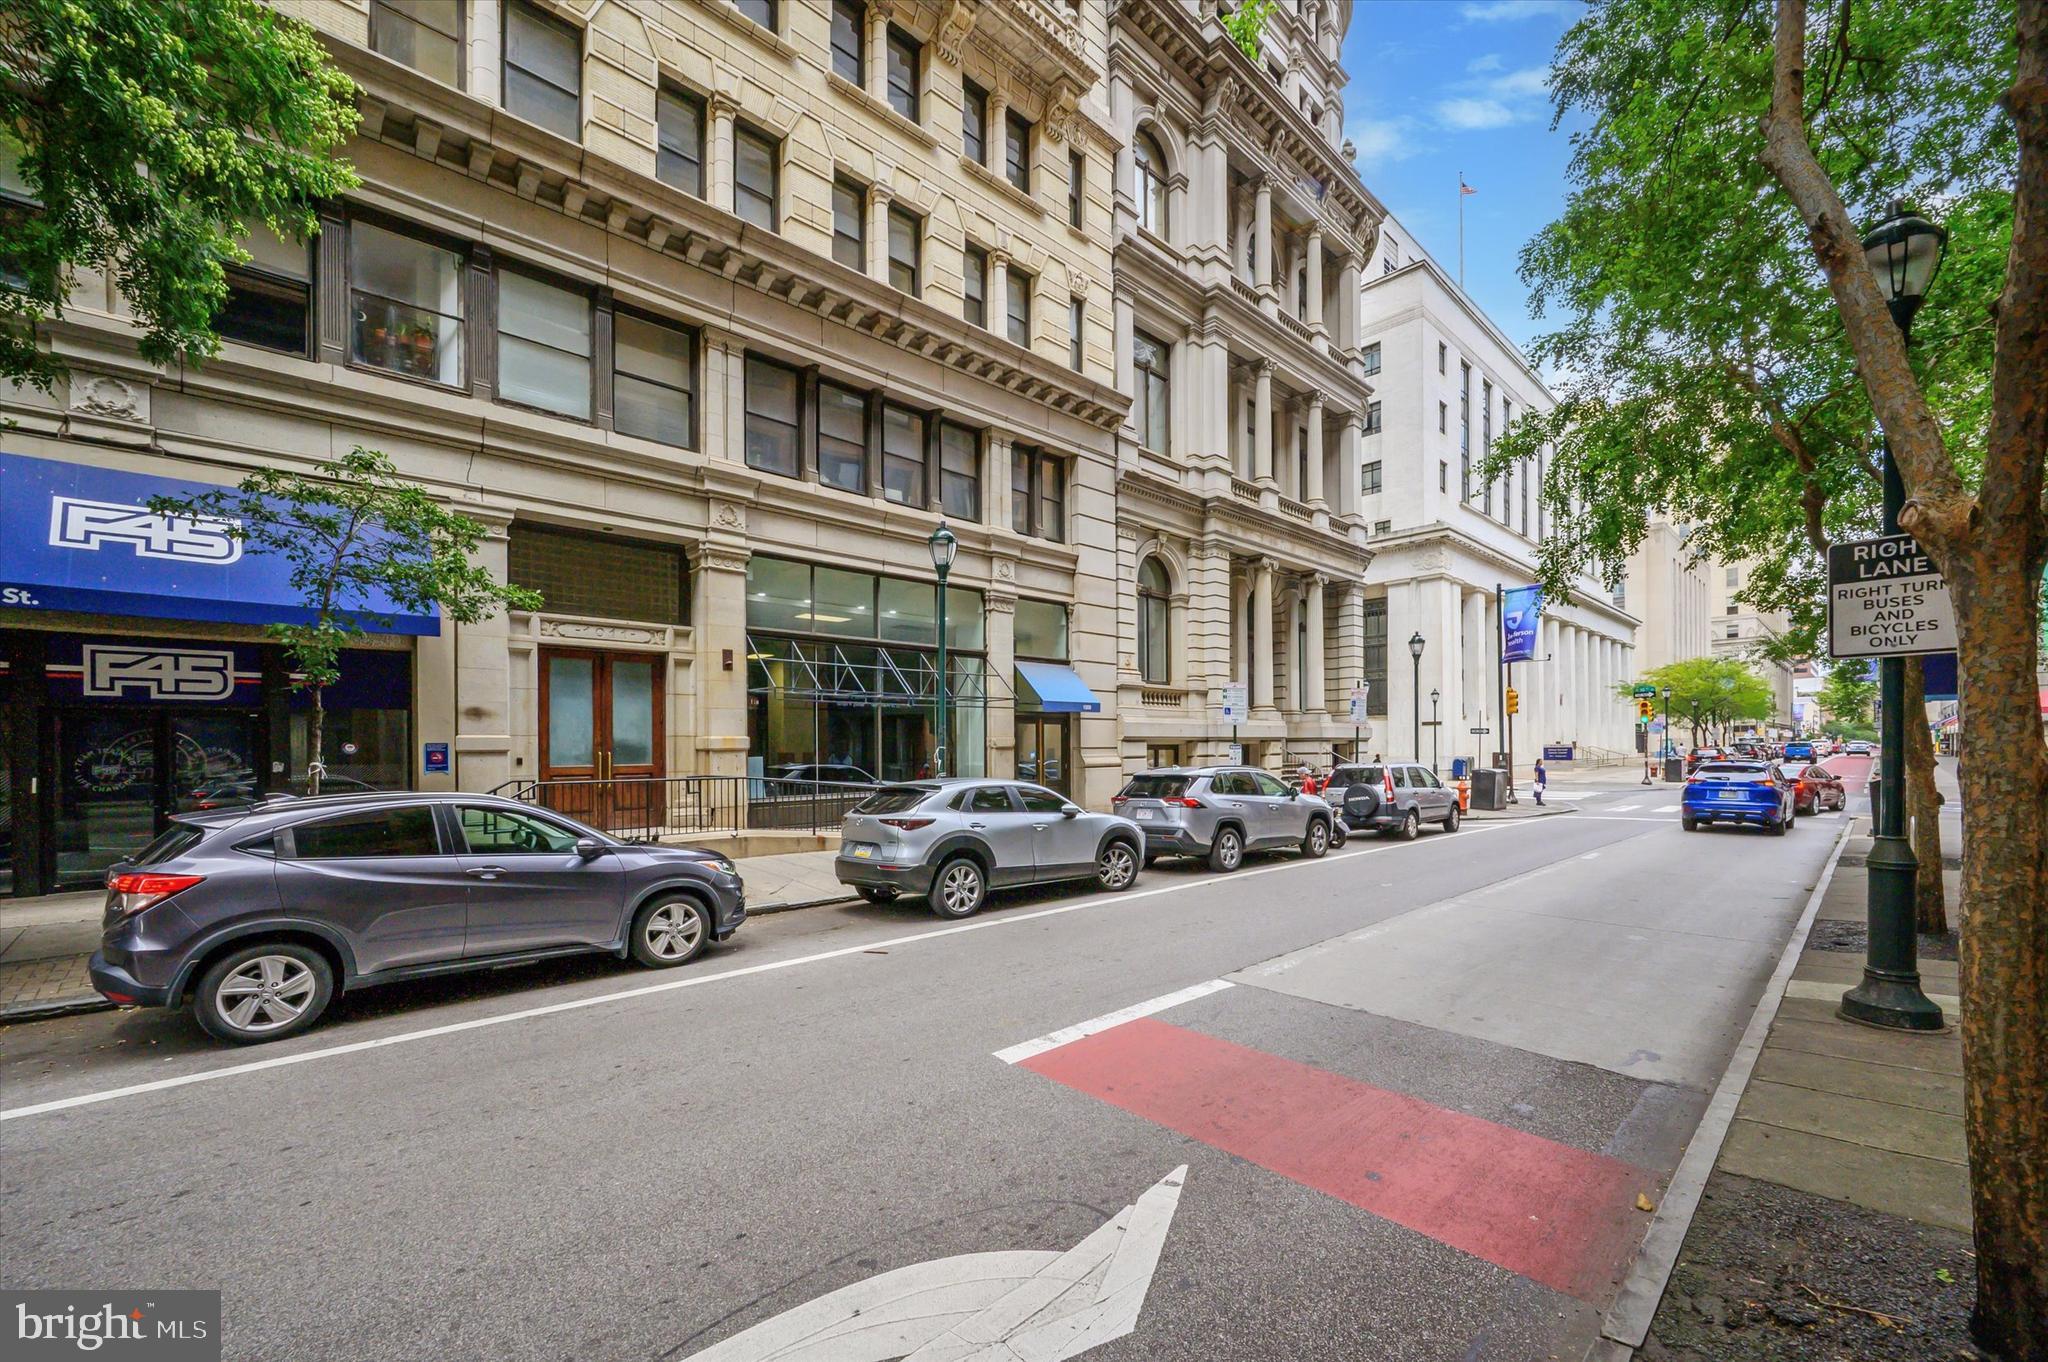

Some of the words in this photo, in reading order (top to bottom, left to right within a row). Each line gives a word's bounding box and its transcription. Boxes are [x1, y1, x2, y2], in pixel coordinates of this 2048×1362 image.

[49, 496, 243, 566] F45
[1854, 539, 1917, 561] RIGH
[1859, 556, 1928, 578] LANE
[2, 588, 40, 606] St.
[1838, 584, 1891, 600] RIGHT
[1863, 595, 1924, 610] BUSES
[1873, 608, 1914, 622] AND
[1850, 619, 1938, 636] BICYCLES
[1869, 634, 1918, 648] ONLY
[83, 643, 235, 700] F45
